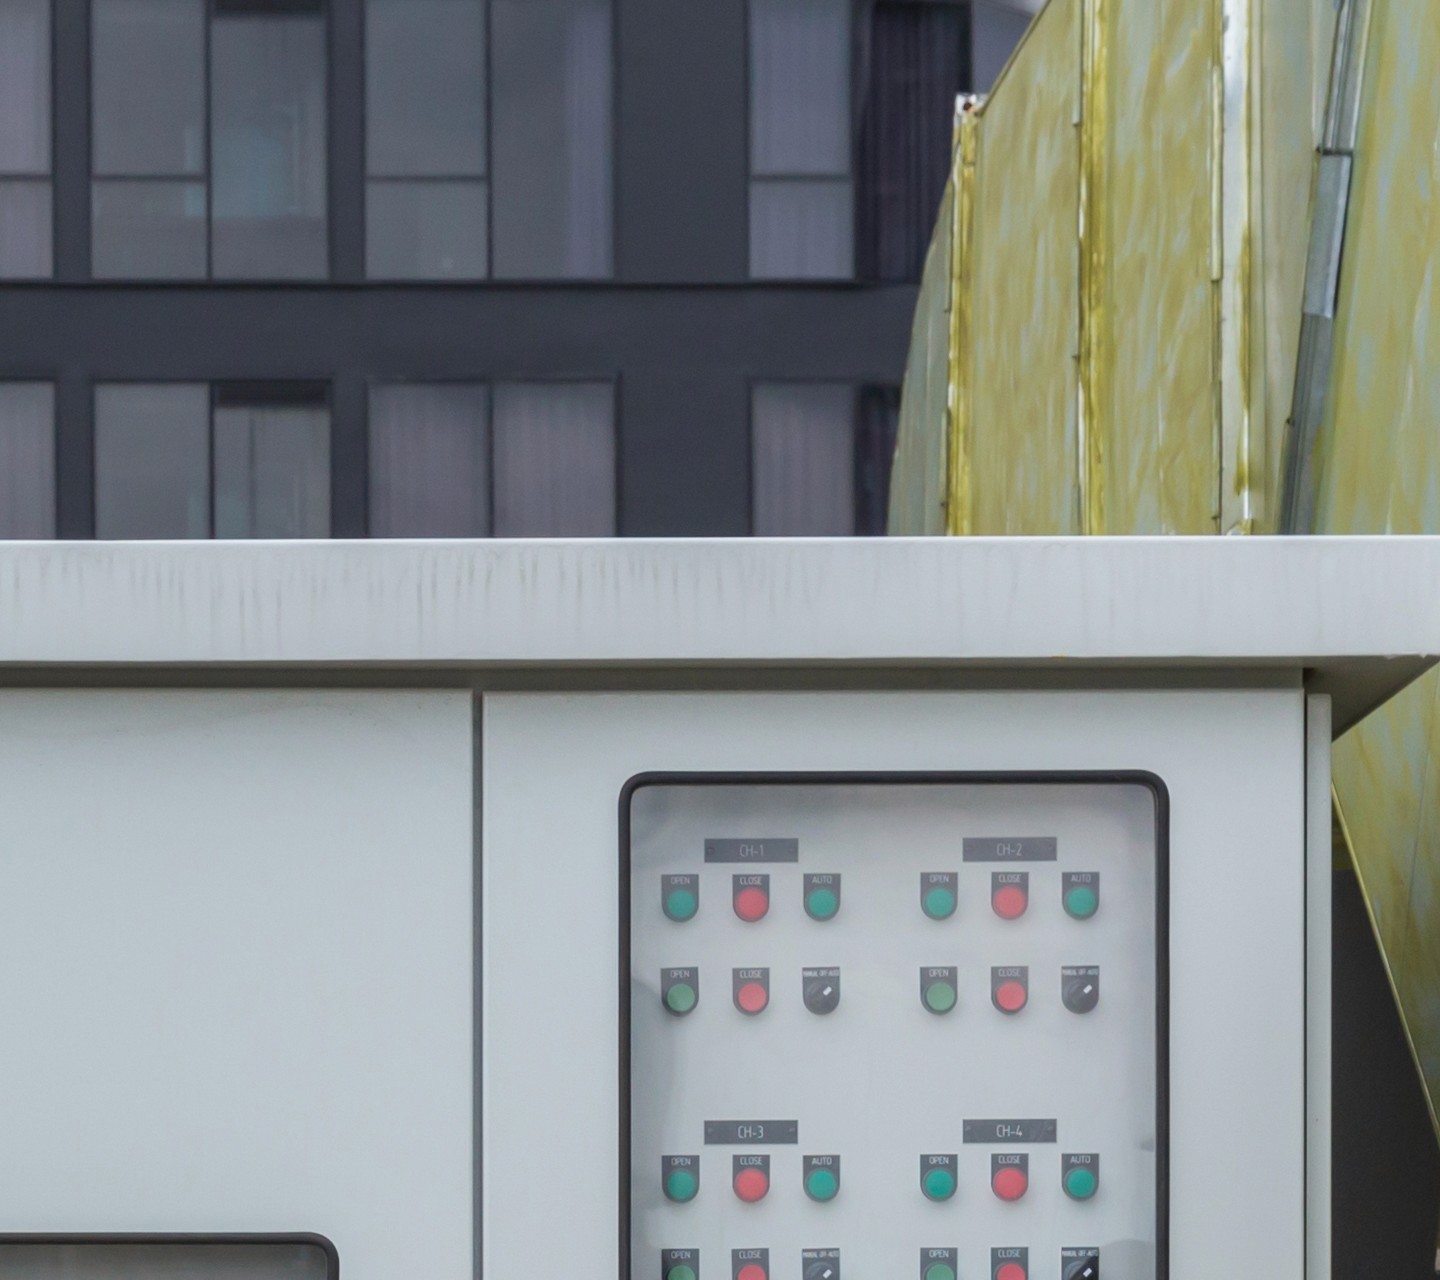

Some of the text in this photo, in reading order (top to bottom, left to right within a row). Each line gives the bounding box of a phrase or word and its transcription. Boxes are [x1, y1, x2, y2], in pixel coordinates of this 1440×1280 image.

[740, 845, 764, 857] CH-1
[996, 843, 1023, 856] CH-2
[671, 876, 690, 885] OPEN
[740, 876, 762, 885] CLOSE
[811, 875, 832, 884] AUTO
[929, 875, 949, 883] OPEN
[998, 874, 1021, 882] CLOSE
[1070, 874, 1091, 883] AUTO
[671, 970, 690, 978] OPEN
[739, 970, 762, 978] CLOSE
[929, 969, 949, 977] OPEN
[998, 968, 1020, 977] CLOSE
[737, 1126, 764, 1138] CH-3
[996, 1125, 1023, 1137] CH-4
[671, 1157, 691, 1165] OPEN
[740, 1157, 763, 1165] CLOSE
[811, 1157, 832, 1165] AUTO
[929, 1156, 949, 1165] OPEN
[998, 1155, 1020, 1164] CLOSE
[1070, 1156, 1091, 1164] AUTO
[671, 1251, 691, 1259] OPEN
[739, 1250, 762, 1259] CLOSE
[929, 1250, 949, 1258] OPEN
[998, 1249, 1020, 1258] CLOSE
